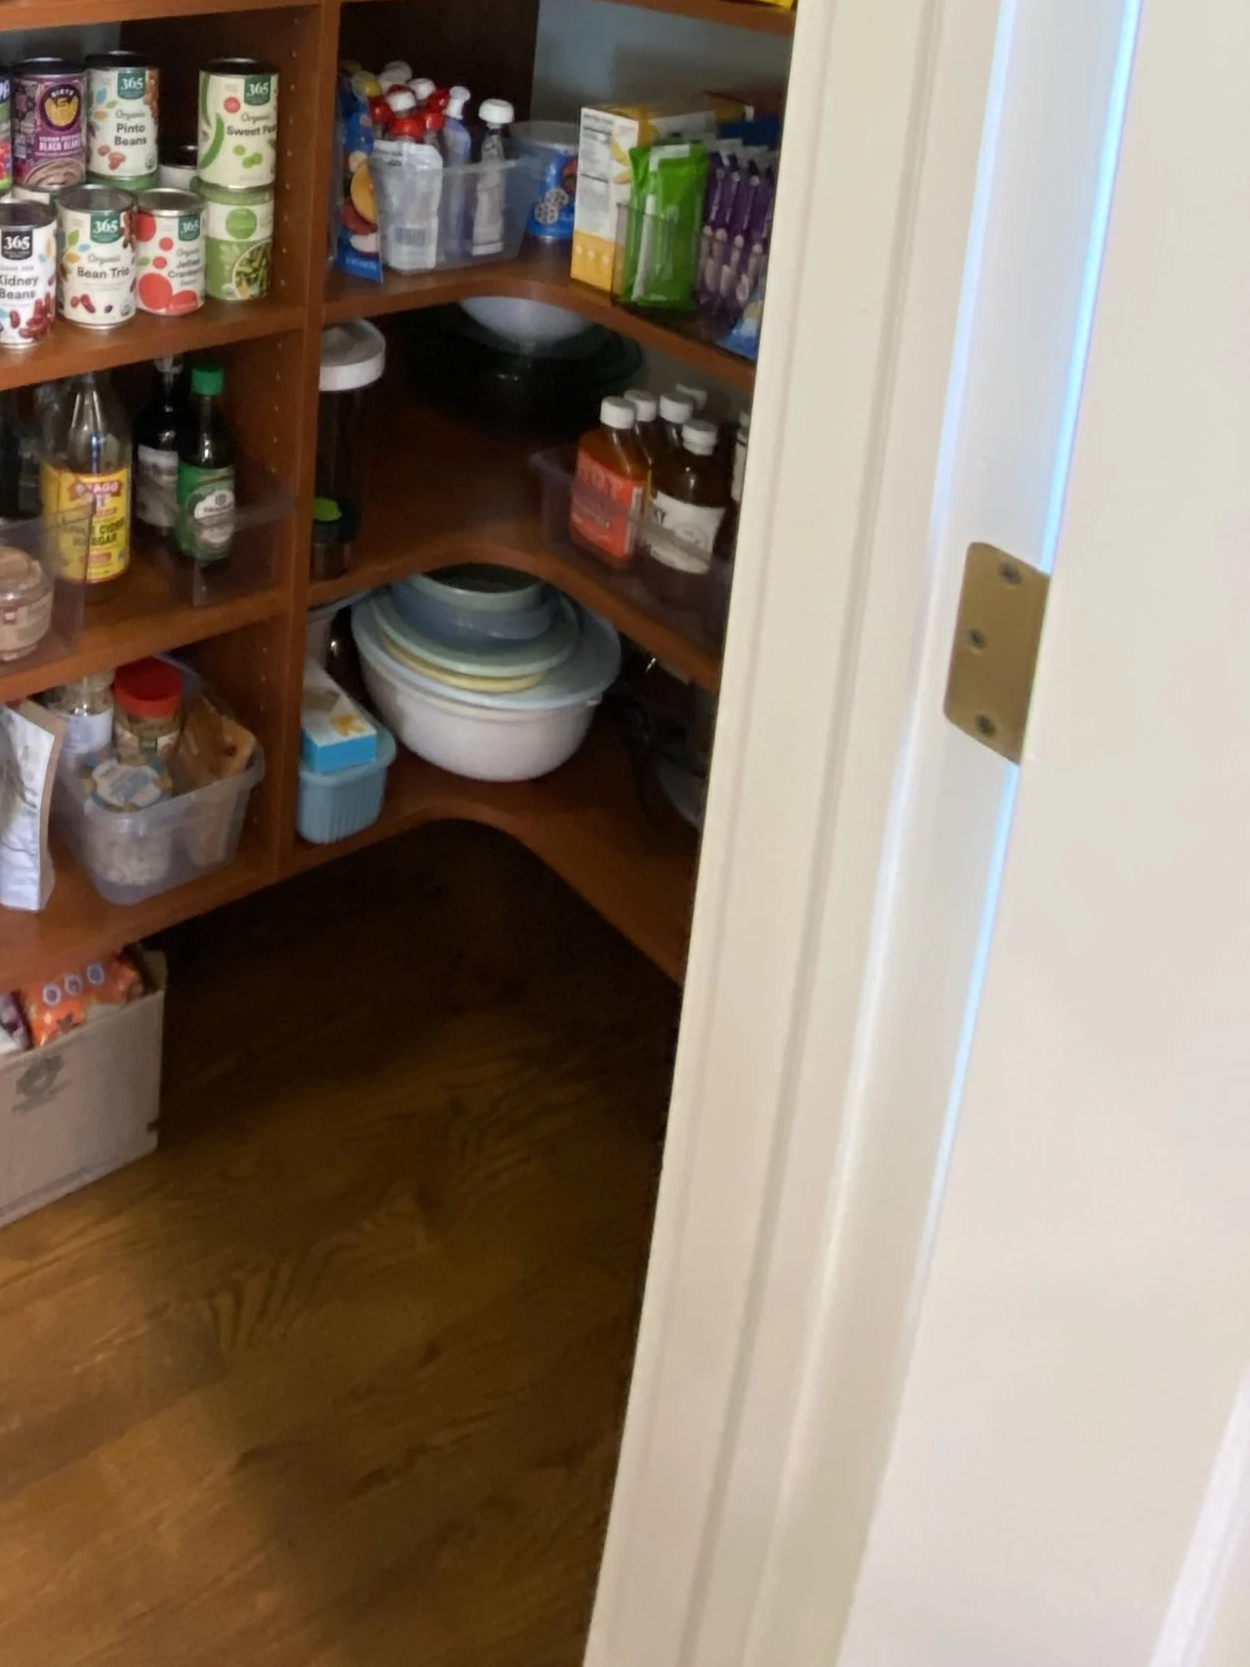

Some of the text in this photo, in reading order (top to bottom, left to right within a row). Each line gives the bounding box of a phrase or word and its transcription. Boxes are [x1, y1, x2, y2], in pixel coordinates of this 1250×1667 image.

[119, 77, 144, 91] 365
[246, 83, 269, 97] 365
[116, 123, 146, 133] Pinto
[226, 126, 261, 136] Sweet
[39, 141, 62, 151] BLACK
[113, 136, 148, 146] Beans
[93, 220, 119, 234] 365
[180, 221, 200, 234] 365
[3, 235, 31, 250] 365
[88, 253, 122, 265] Organic
[77, 265, 131, 279] Bean Trio
